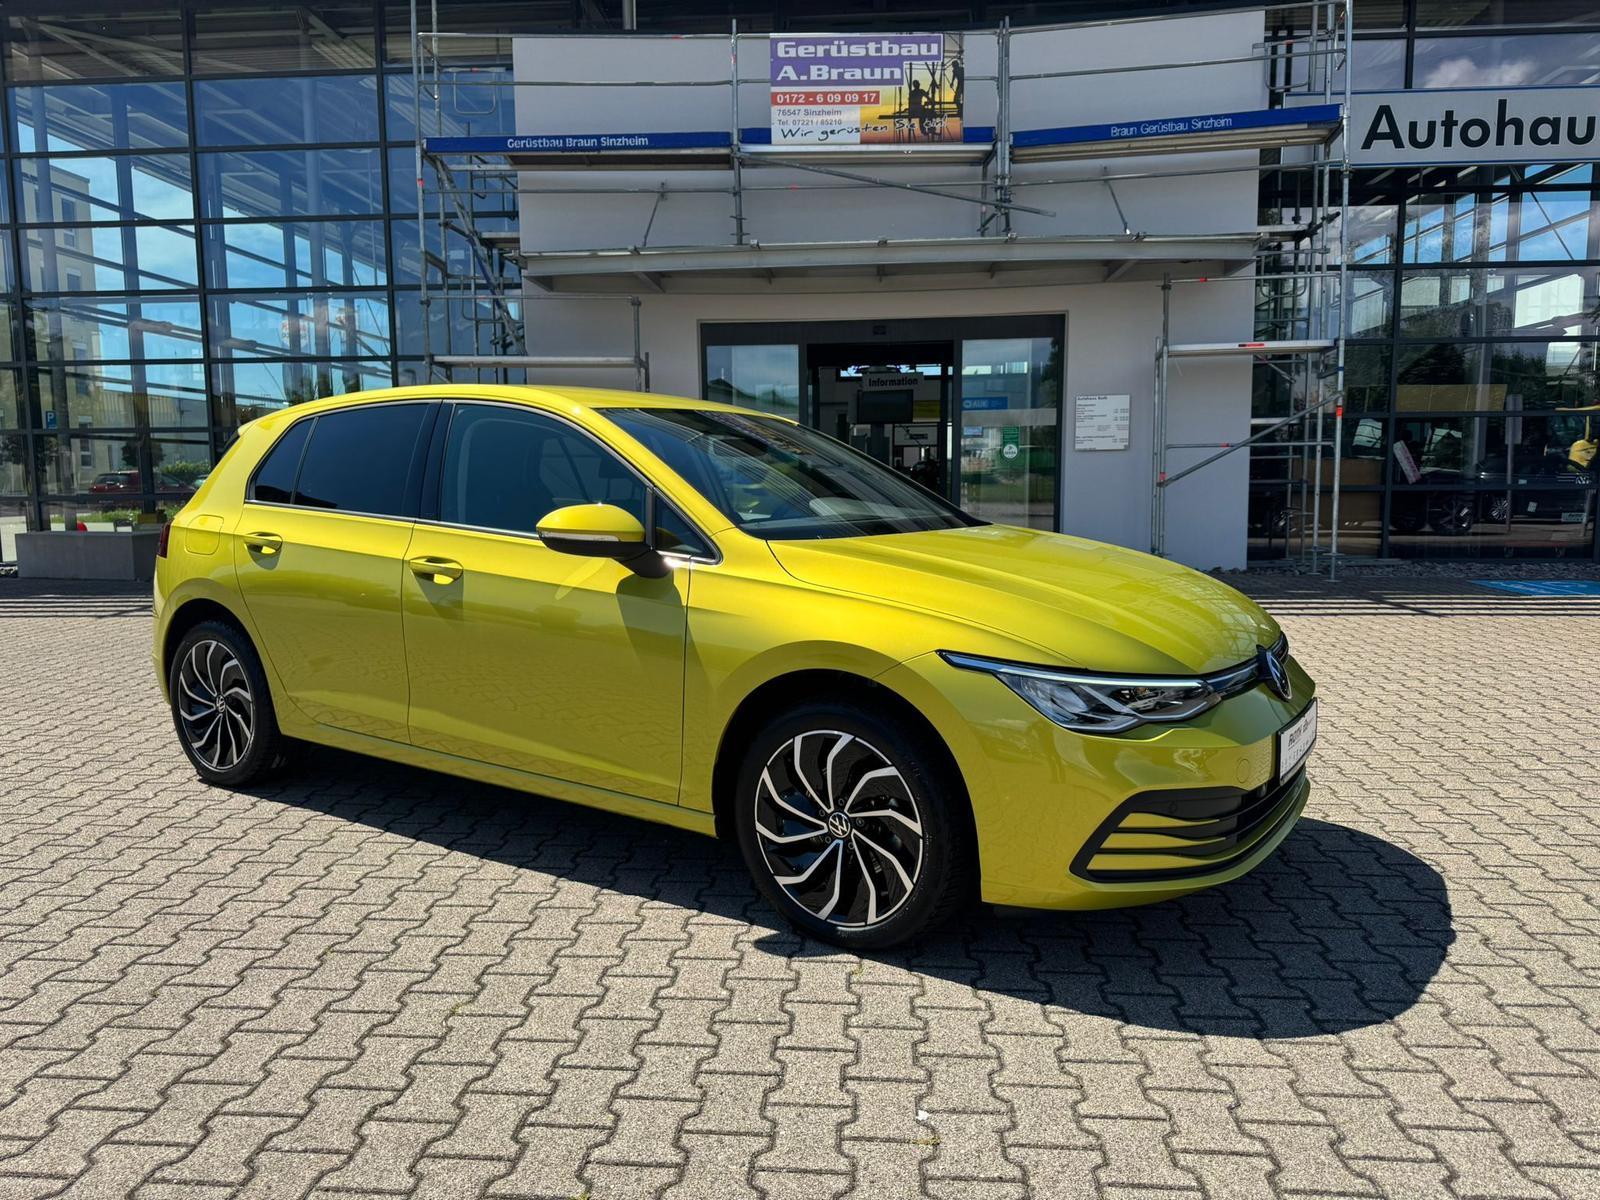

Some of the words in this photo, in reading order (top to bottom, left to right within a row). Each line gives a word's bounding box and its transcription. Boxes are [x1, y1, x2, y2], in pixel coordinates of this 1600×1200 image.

[776, 40, 939, 58] Gerüstbau
[776, 65, 902, 81] A.Braun
[776, 94, 805, 104] 0172
[816, 94, 824, 103] 6
[827, 93, 841, 103] 09
[845, 93, 859, 103] 09
[862, 92, 877, 102] 17
[777, 108, 801, 117] 76547
[803, 108, 842, 116] Sinzheim
[1110, 126, 1137, 137] Braun
[1140, 120, 1188, 134] Gerüstbau
[1191, 116, 1232, 130] Sinzheim
[781, 128, 814, 139] Wir
[507, 138, 563, 149] Gerüstbau
[565, 138, 597, 147] Braun
[600, 136, 649, 147] Sinzheim
[868, 377, 919, 387] Information
